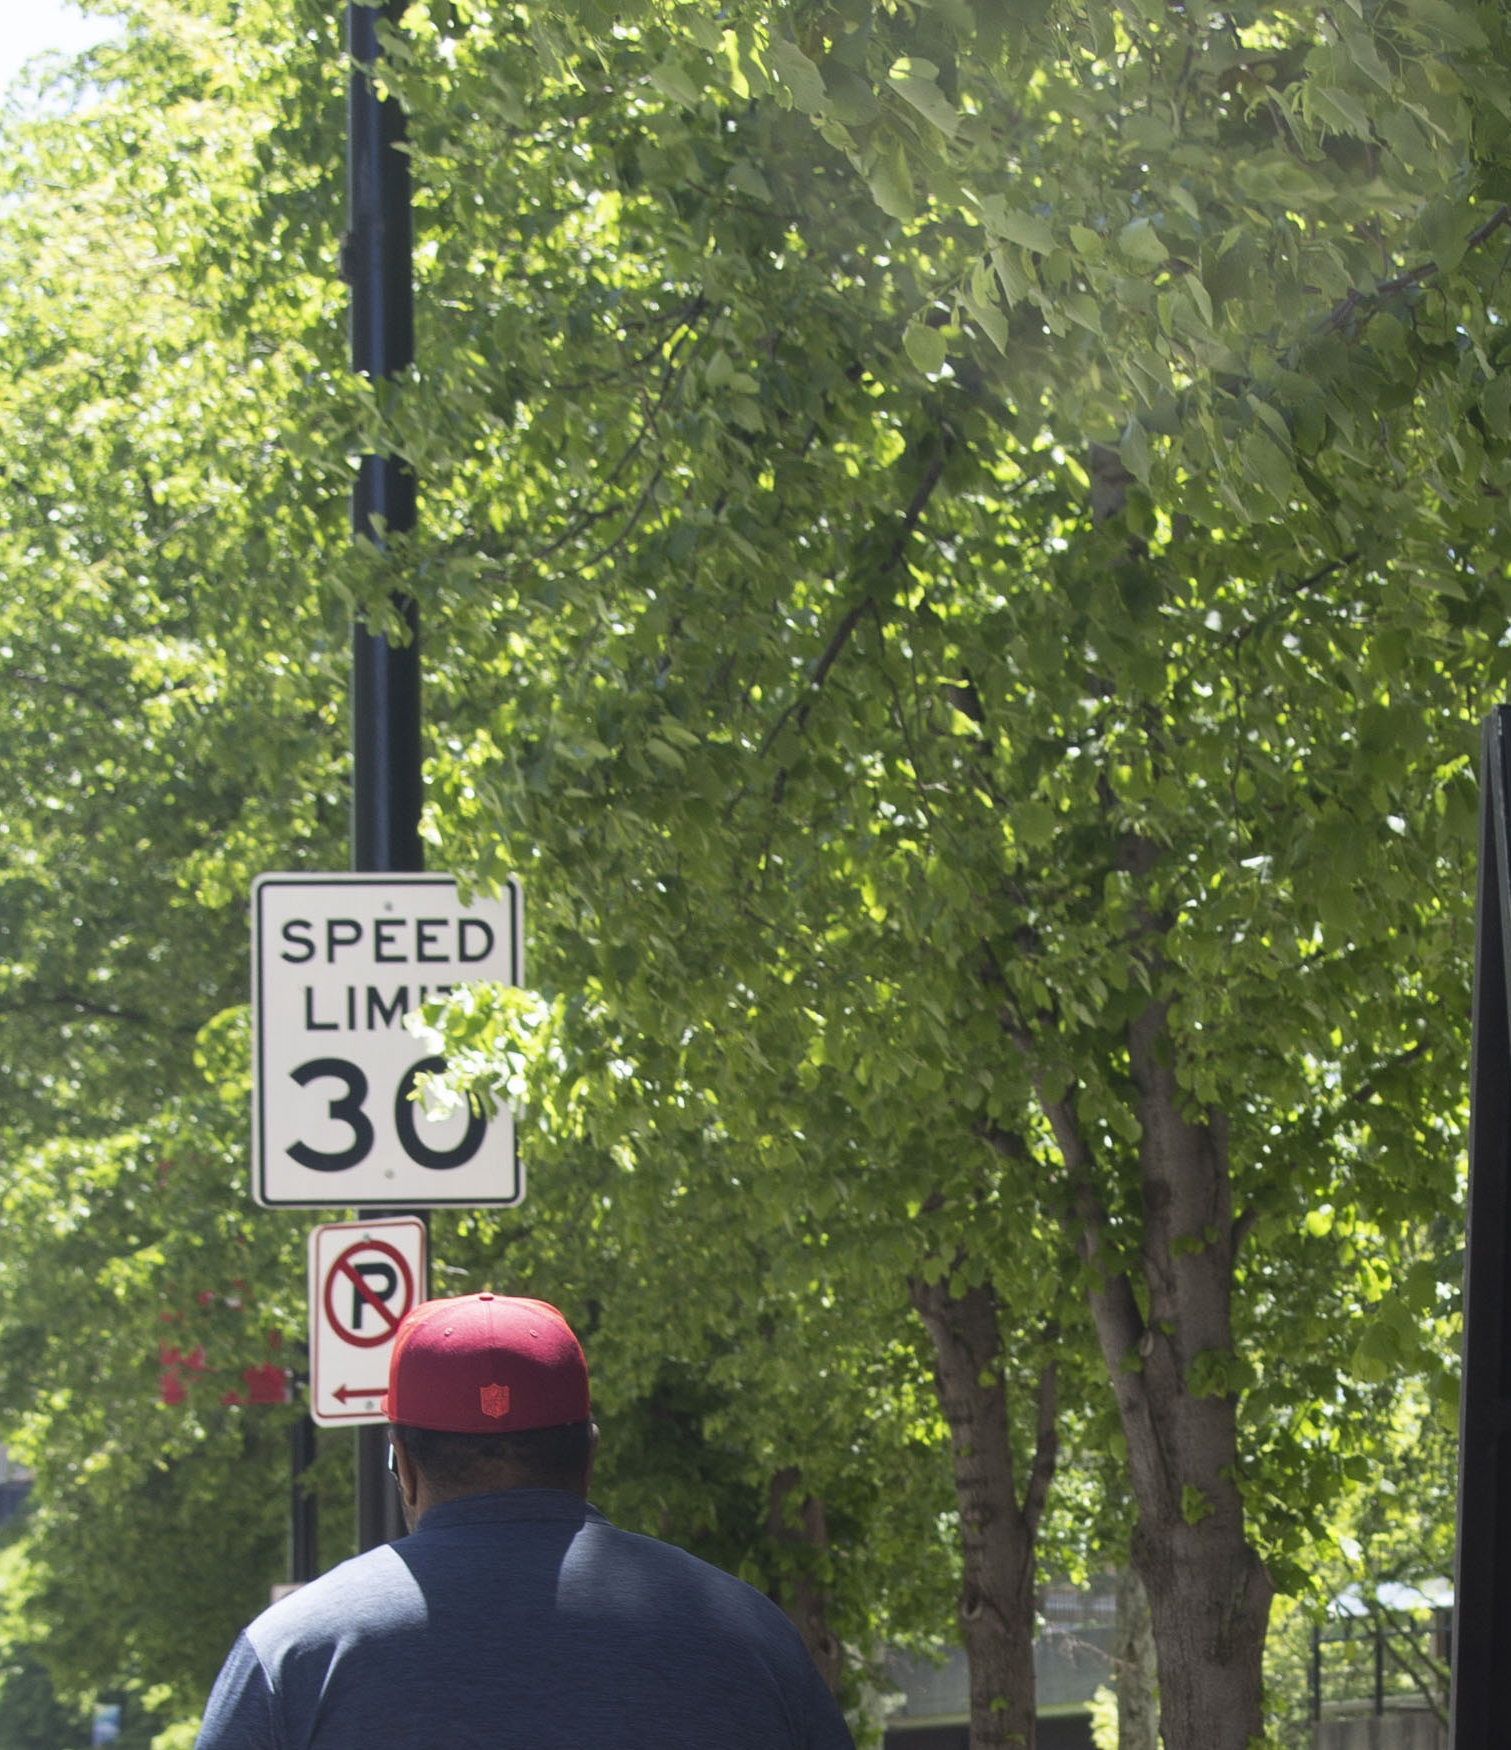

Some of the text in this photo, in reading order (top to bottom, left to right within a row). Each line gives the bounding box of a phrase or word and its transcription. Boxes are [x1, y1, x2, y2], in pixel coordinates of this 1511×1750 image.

[280, 918, 495, 964] SPEED
[305, 985, 453, 1031] LIM
[286, 1057, 488, 1172] 30
